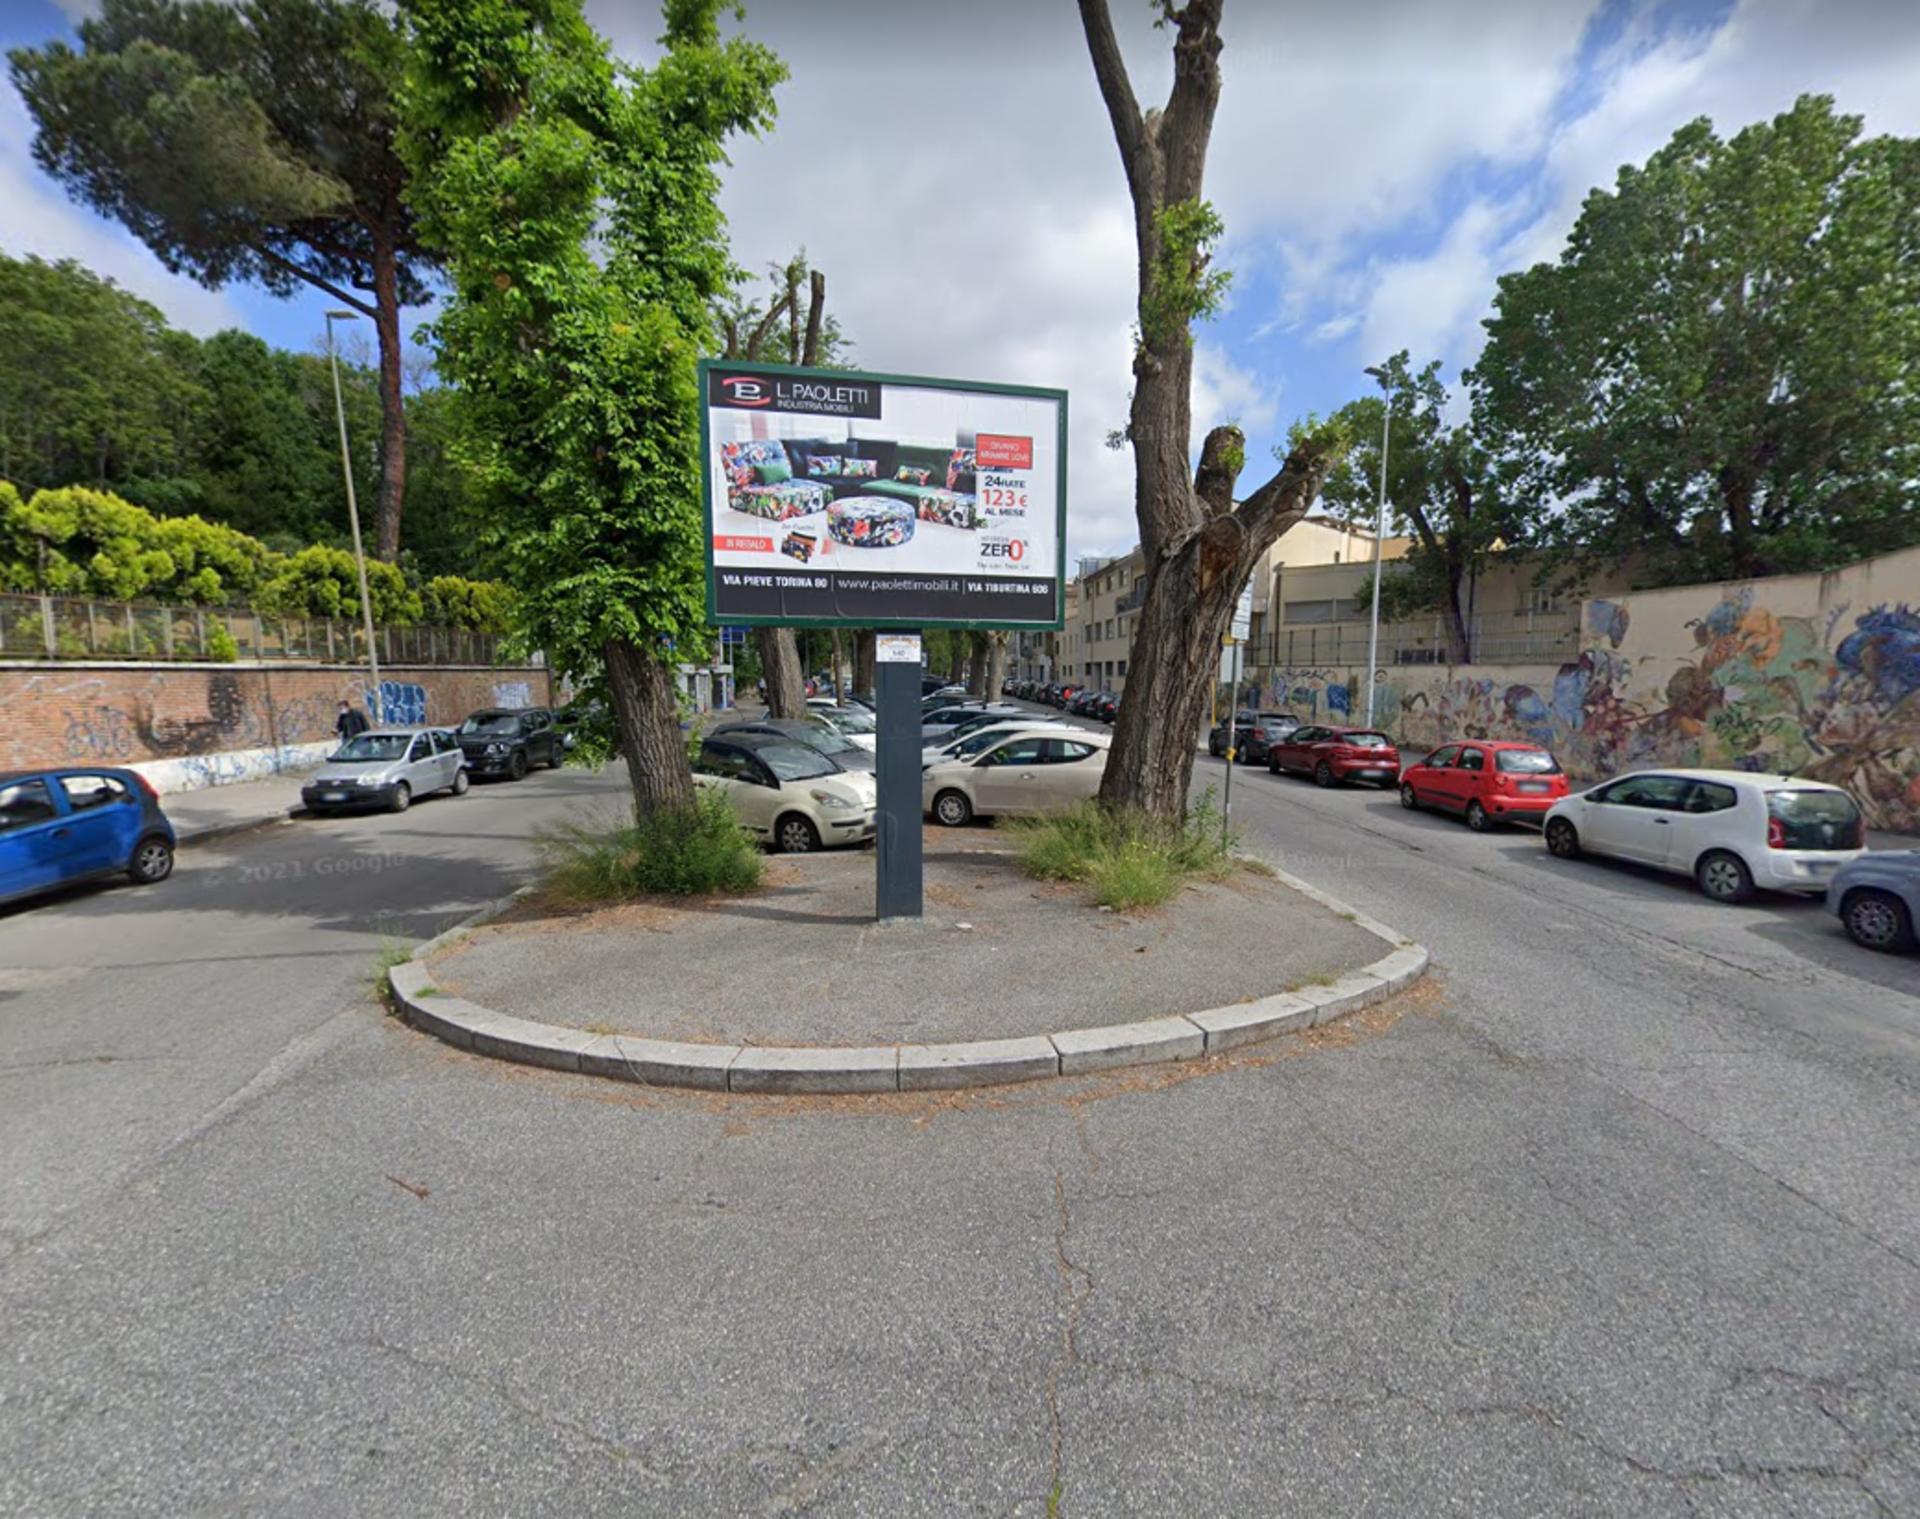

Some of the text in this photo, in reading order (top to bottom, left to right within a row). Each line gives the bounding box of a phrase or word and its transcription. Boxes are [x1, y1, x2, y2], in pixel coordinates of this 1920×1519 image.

[793, 384, 868, 404] PAOLETTI
[777, 400, 854, 413] INDUSTRIA MOBILI
[982, 489, 1015, 507] 123
[984, 507, 1025, 517] AL MESE
[735, 538, 766, 550] REGALO
[722, 574, 741, 586] VIA
[744, 575, 773, 587] PIEVE
[775, 576, 812, 588] TORINA
[967, 581, 983, 593] VIA
[984, 582, 1030, 594] TIBURTINA
